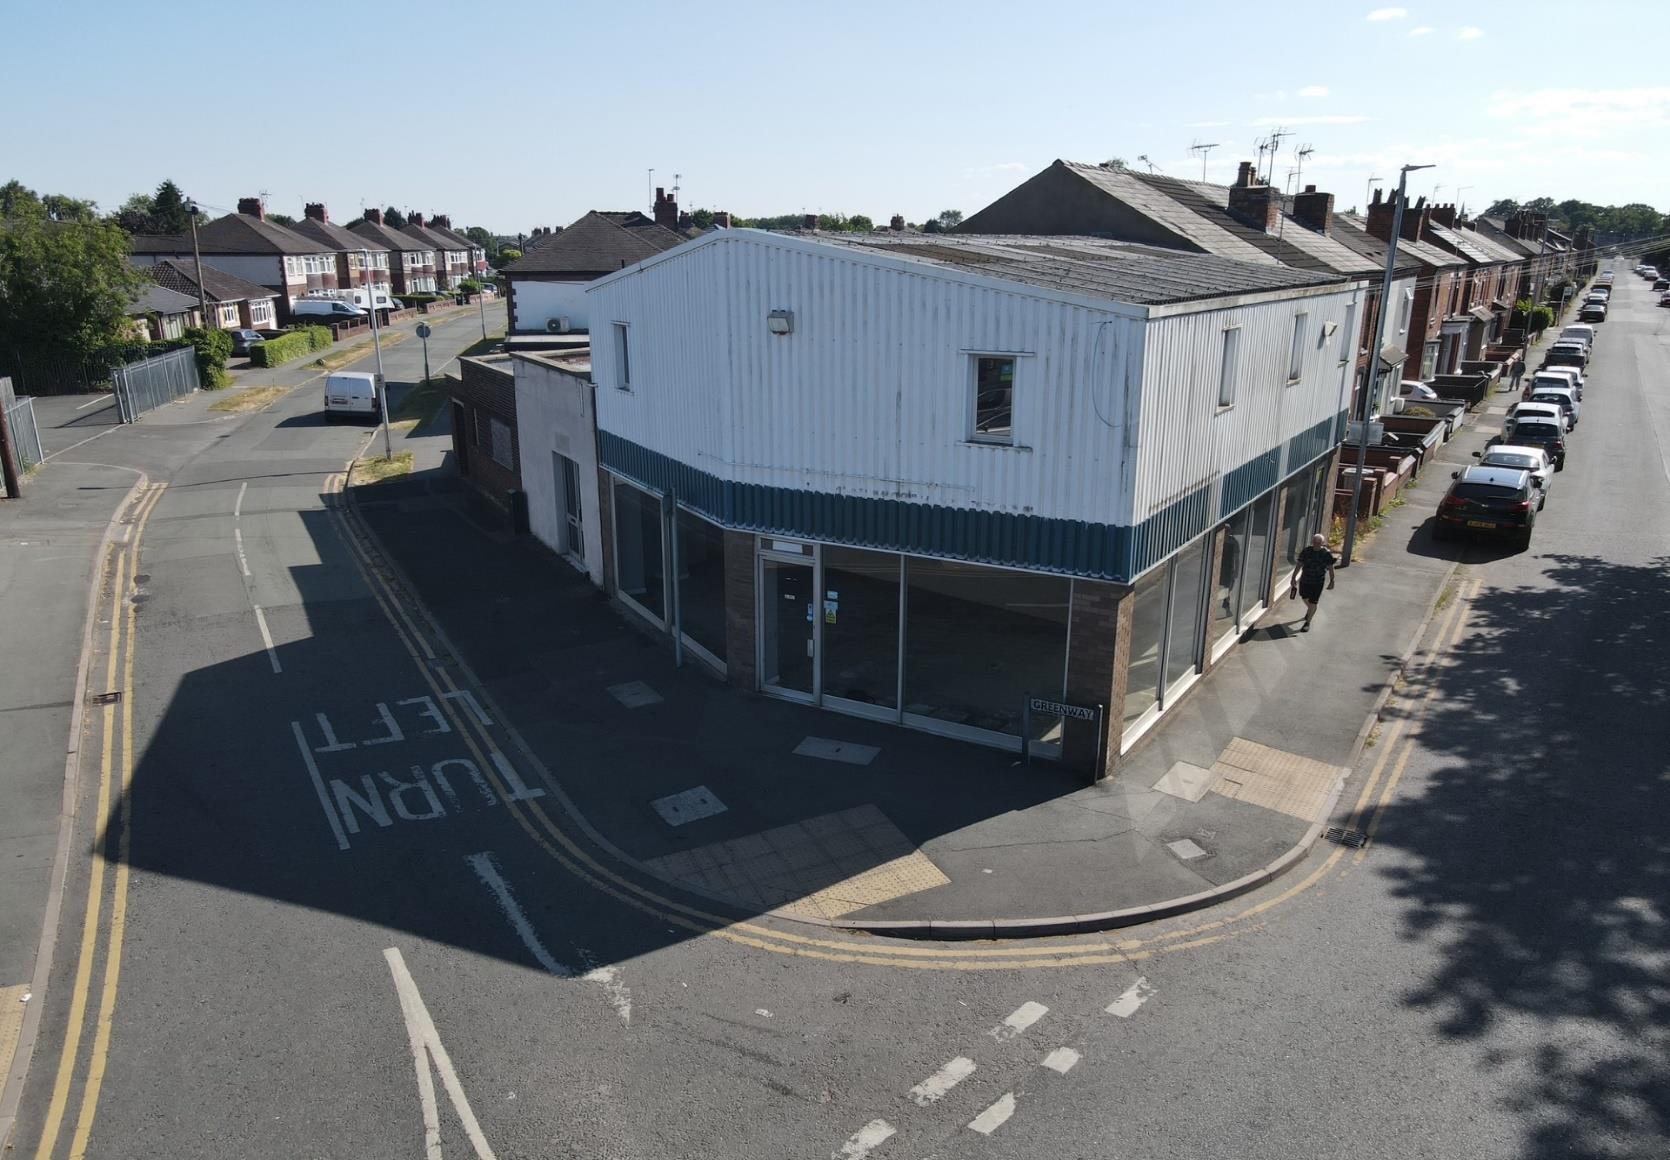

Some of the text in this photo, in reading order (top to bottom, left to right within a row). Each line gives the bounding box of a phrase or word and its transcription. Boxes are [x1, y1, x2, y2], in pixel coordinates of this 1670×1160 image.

[315, 690, 494, 752] LEFT
[1033, 700, 1092, 719] GREENWAY
[329, 753, 547, 834] TURN
